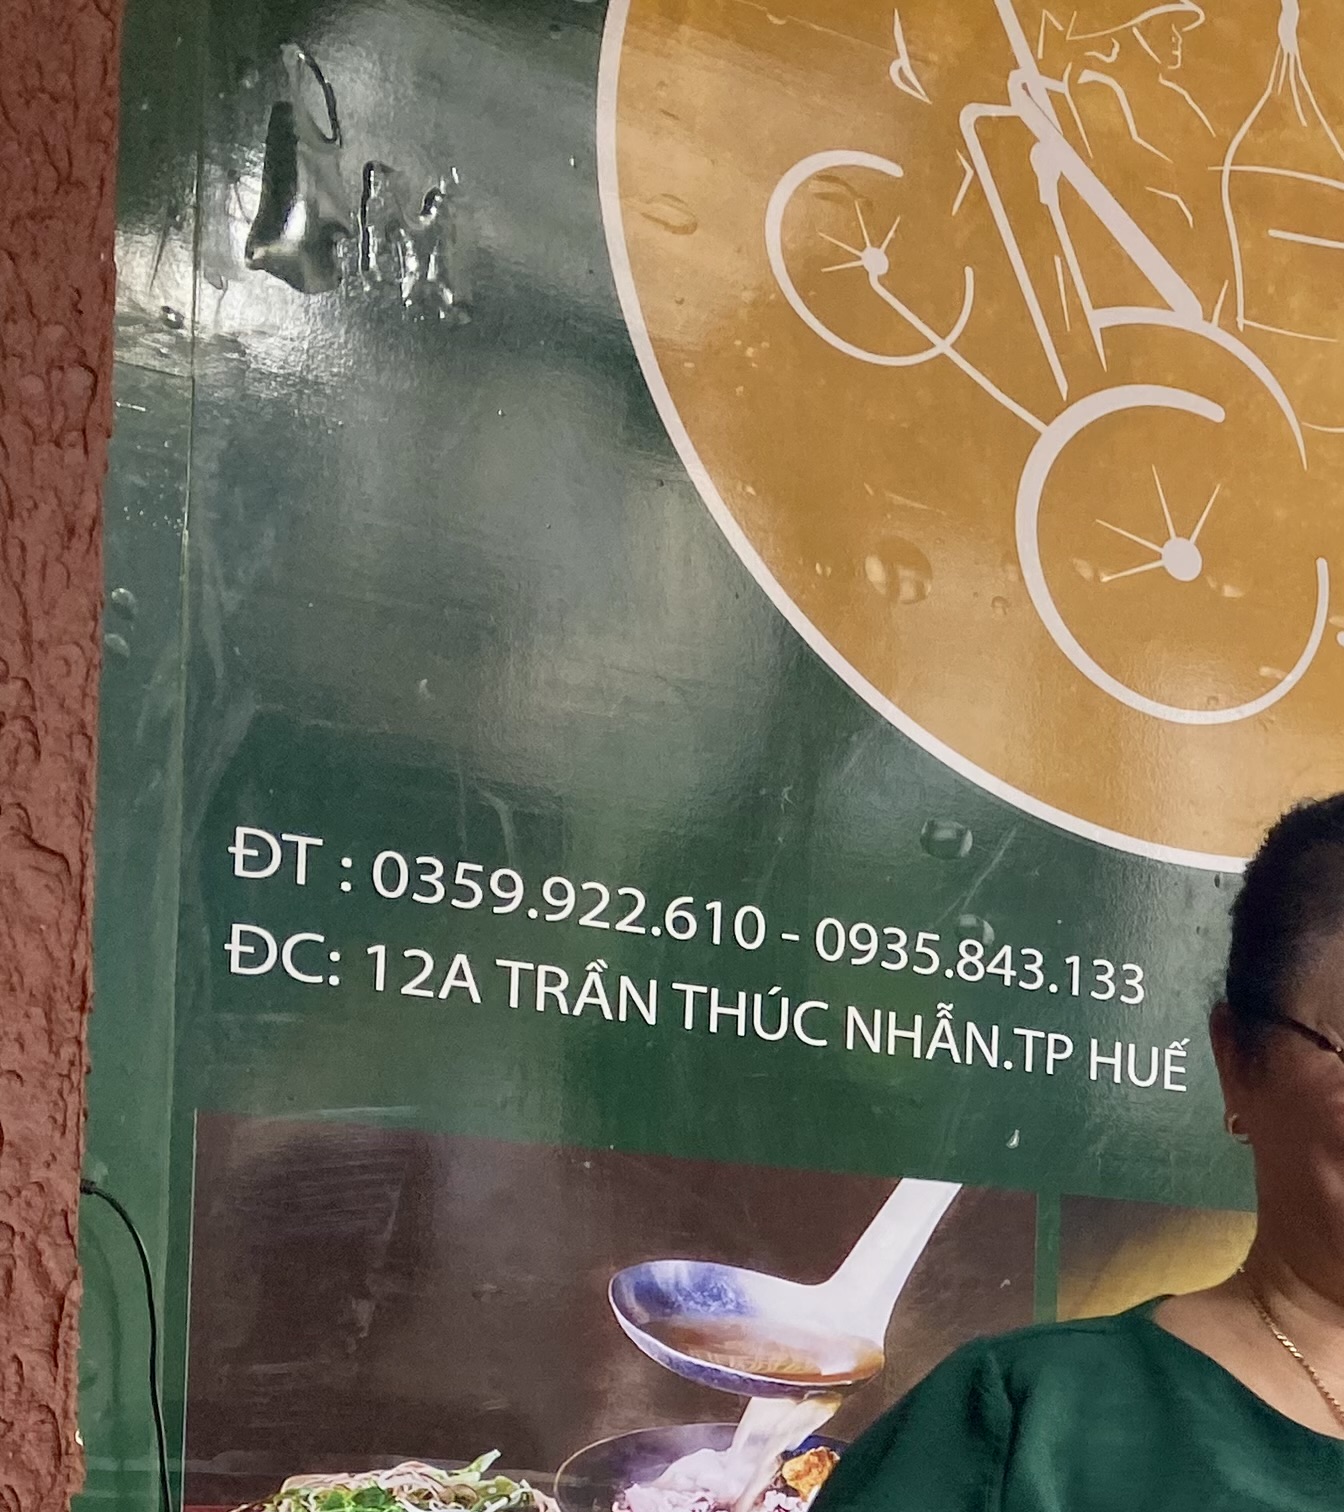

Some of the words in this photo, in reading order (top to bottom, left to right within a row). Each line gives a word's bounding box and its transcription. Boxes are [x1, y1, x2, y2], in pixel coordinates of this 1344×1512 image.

[228, 825, 324, 888] ĐT
[372, 851, 766, 950] 0359.922.610
[815, 917, 1147, 1004] 0935.843.133
[224, 924, 342, 986] ĐC:
[365, 942, 482, 1004] 12A
[496, 956, 659, 1026] TRẦN
[673, 976, 829, 1047] THÚC
[846, 1003, 1075, 1078] NHẪN.TP
[1088, 1037, 1190, 1092] HUẾ
